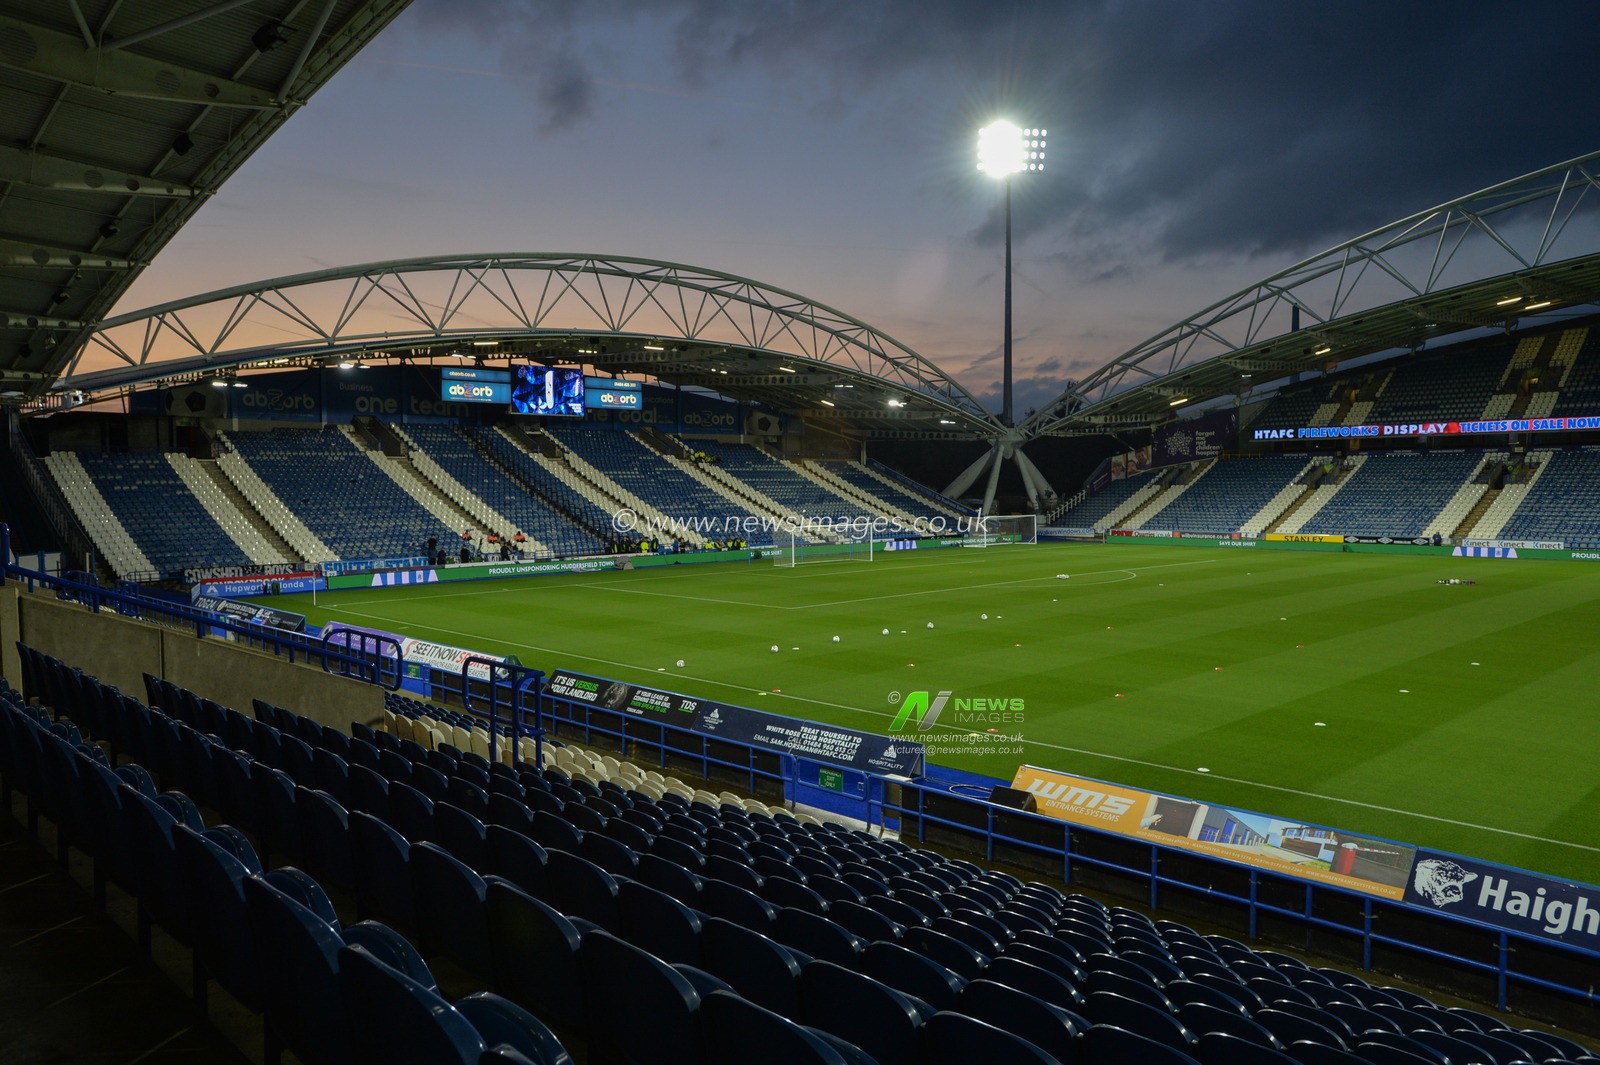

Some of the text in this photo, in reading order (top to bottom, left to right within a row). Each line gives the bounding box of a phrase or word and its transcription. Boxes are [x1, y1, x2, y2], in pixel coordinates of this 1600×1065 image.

[339, 382, 373, 392] Business
[355, 396, 397, 413] one
[1254, 417, 1600, 439] HTAFC FIREWORKS DISPLAY TICKETS ON SALE NOW
[1284, 535, 1324, 543] STANLEY
[489, 559, 615, 575] PROUDLY UNSPONSORING HUDDERSFIELD TOWN
[554, 675, 600, 692] IT'S US VERSUS
[551, 683, 598, 702] YOUR LANDLORD
[680, 699, 697, 711] TDS
[753, 734, 769, 743] EMAIL
[766, 725, 860, 750] WHITE ROSE CLUB HOSPITALITY
[801, 726, 862, 744] TREAT YOURSELF TO
[788, 735, 802, 745] CALL
[846, 748, 857, 756] OR
[867, 759, 904, 770] HOSPITALITY
[1045, 800, 1120, 822] ENTRANCE SYSTEMS
[1478, 874, 1600, 936] Haigh
